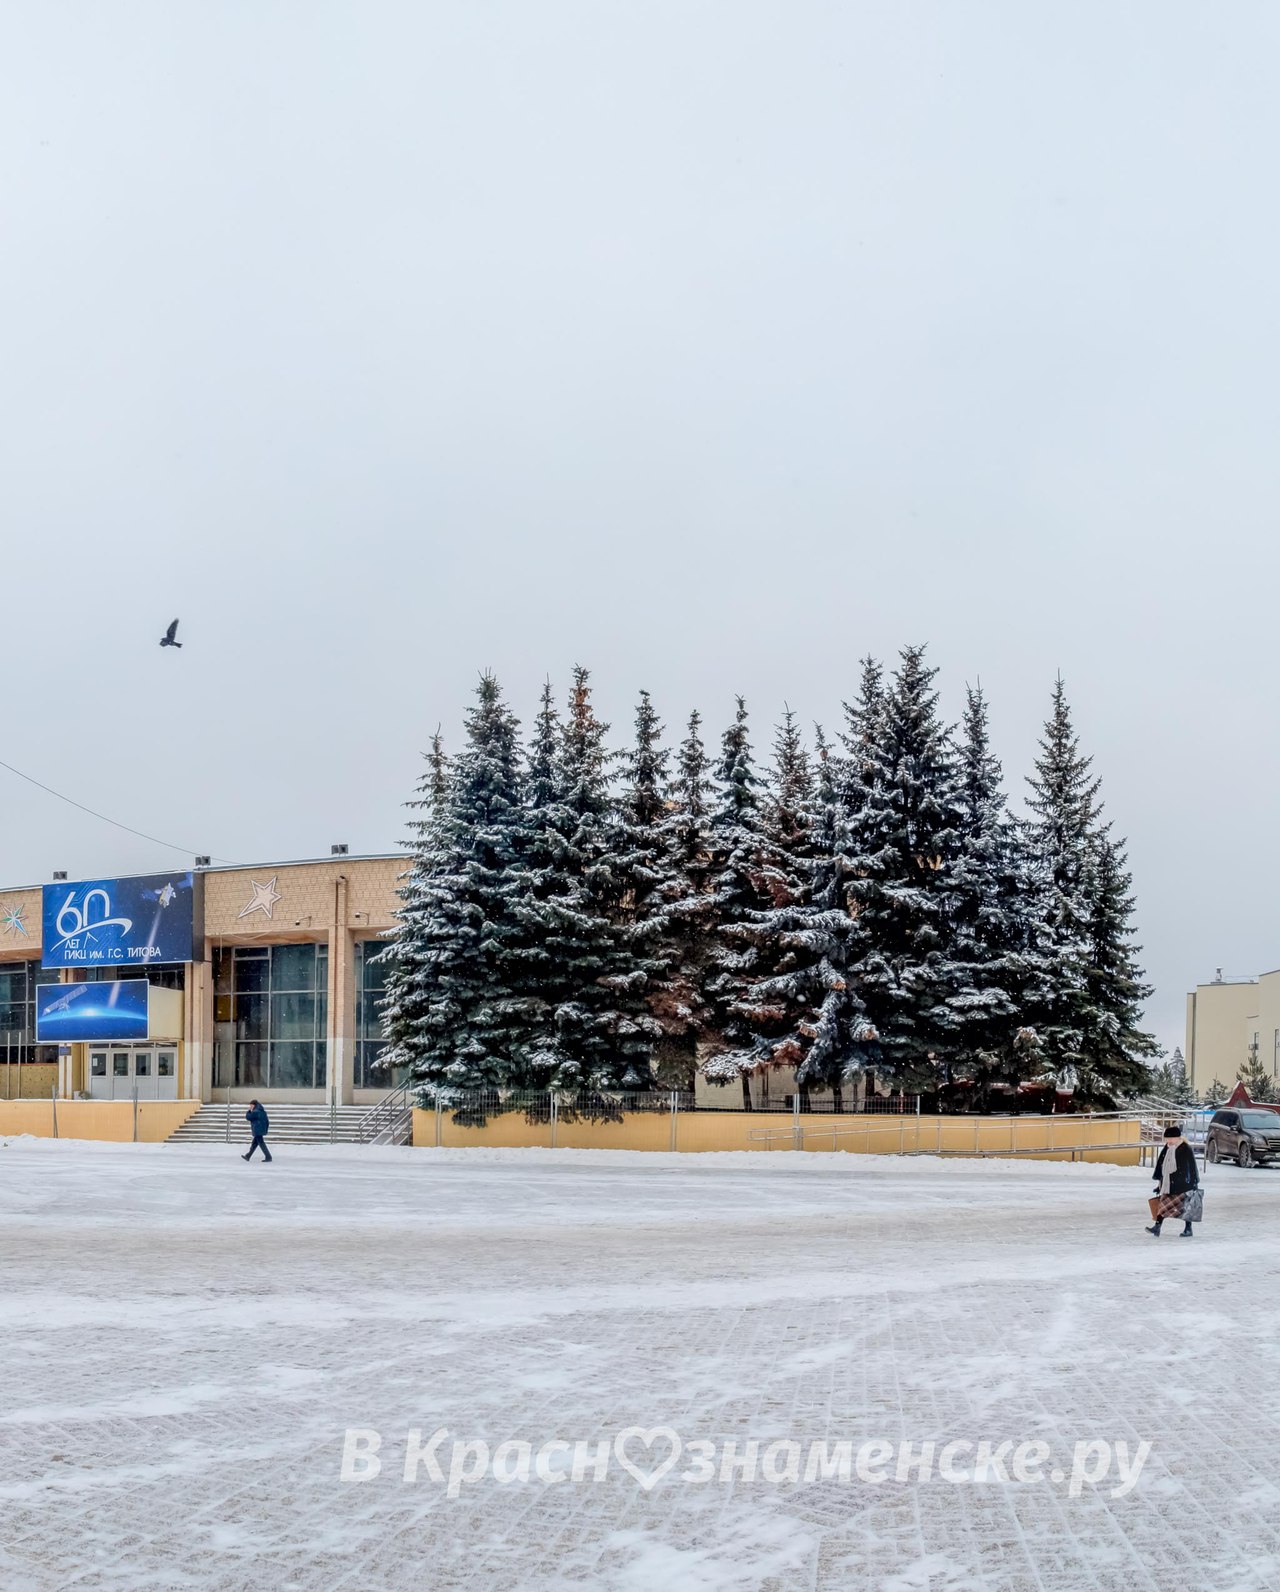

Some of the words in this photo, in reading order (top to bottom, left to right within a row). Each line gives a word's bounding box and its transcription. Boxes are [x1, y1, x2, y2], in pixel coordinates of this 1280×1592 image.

[65, 939, 80, 949] ЛЕТ
[64, 950, 87, 960] ГИКЦ
[127, 946, 162, 957] ТИТОВА
